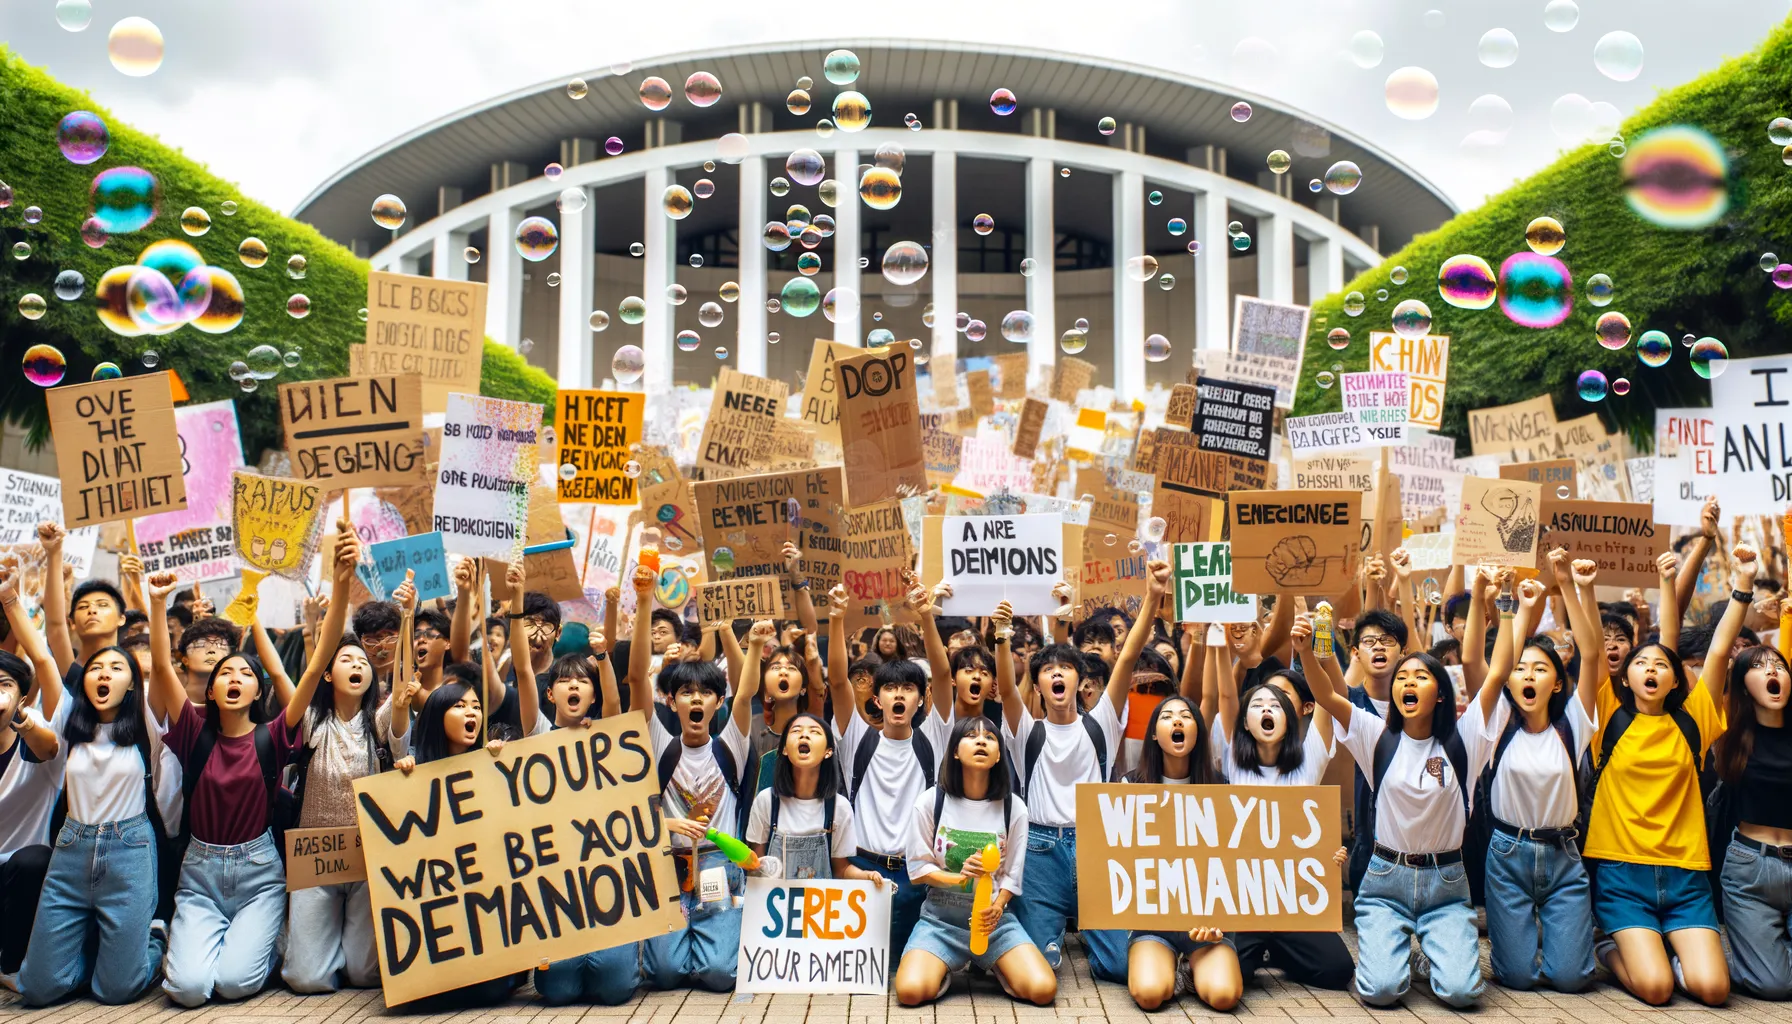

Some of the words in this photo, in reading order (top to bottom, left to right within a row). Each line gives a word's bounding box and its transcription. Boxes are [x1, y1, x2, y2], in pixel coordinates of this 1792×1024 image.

[75, 389, 136, 418] OVE
[1410, 382, 1441, 421] DS
[1750, 367, 1790, 407] I
[88, 416, 136, 443] THE
[564, 422, 589, 446] NE
[358, 769, 484, 846] WE
[494, 730, 651, 808] YOURS
[380, 842, 484, 900] WRE
[503, 824, 560, 880] BE
[1107, 857, 1329, 916] DEMIANNS
[761, 886, 867, 940] SERES
[743, 945, 801, 983] YOUR
